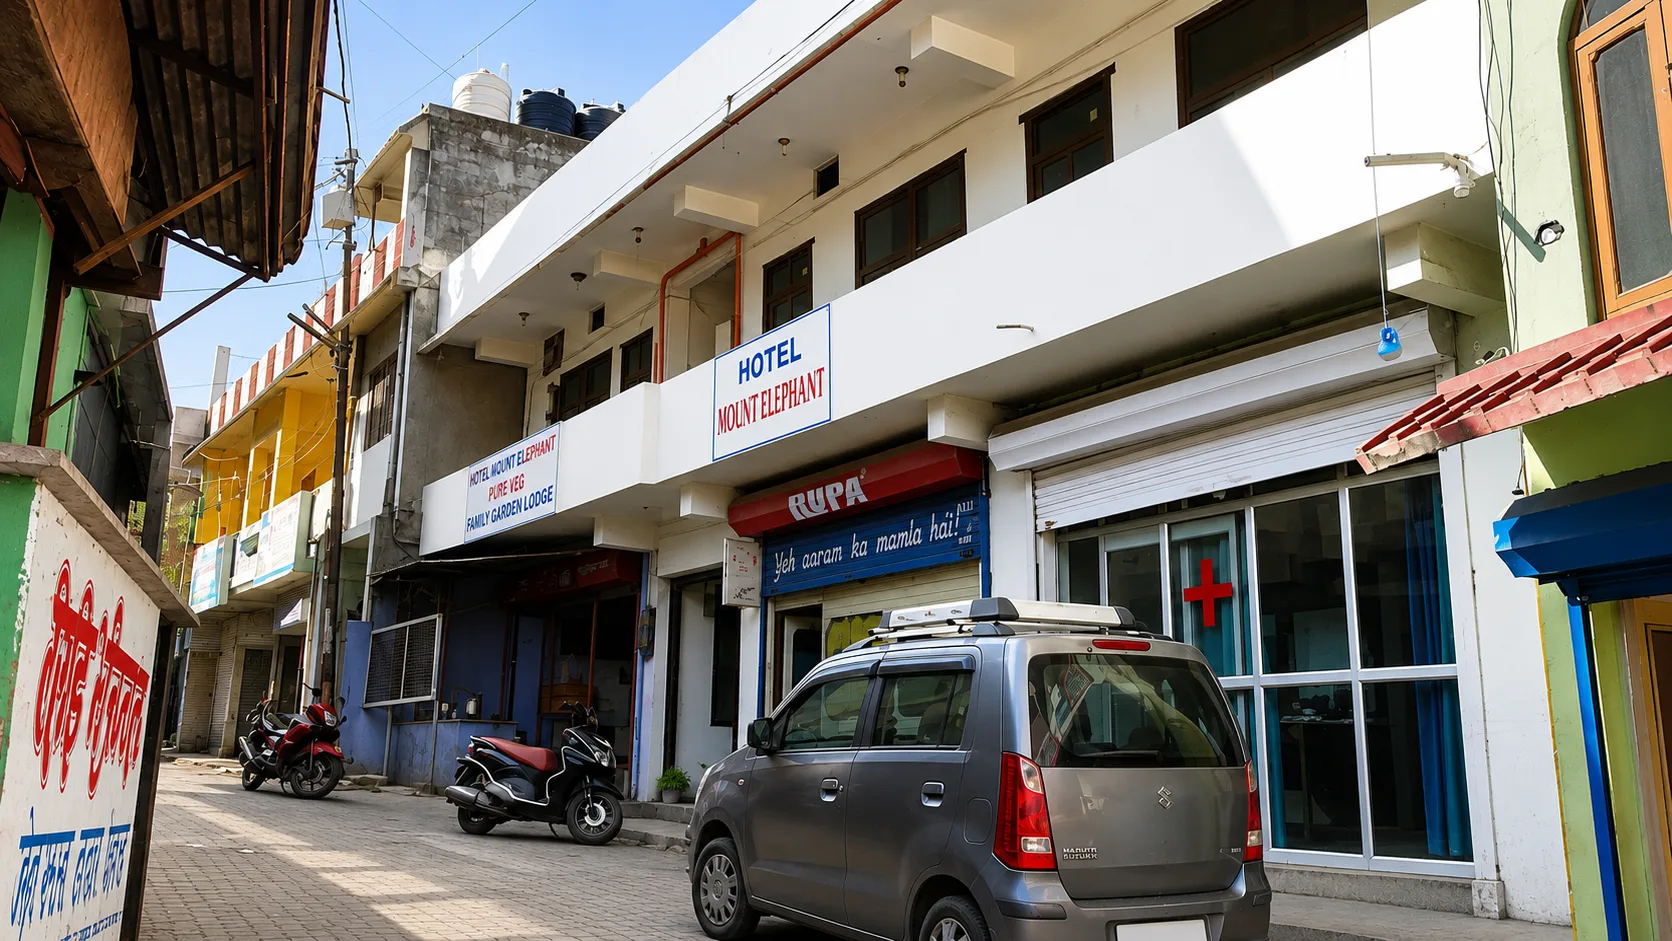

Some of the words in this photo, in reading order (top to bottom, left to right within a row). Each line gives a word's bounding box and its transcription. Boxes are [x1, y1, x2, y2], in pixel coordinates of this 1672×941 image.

[739, 336, 802, 385] HOTEL
[717, 393, 759, 435] MOUNT
[760, 367, 825, 420] ELEPHANT
[470, 467, 490, 487] HOTEL
[491, 453, 516, 477] MOUNT
[516, 434, 557, 466] ELEPHANT
[467, 509, 491, 532] FAMILY
[491, 497, 522, 523] GARDEN
[523, 484, 554, 512] LODGE
[488, 478, 508, 502] PURE
[509, 473, 525, 494] VEG
[788, 477, 868, 520] RUPA
[773, 551, 796, 583] Yeh
[802, 545, 843, 569] aaram
[850, 532, 868, 558] ka
[876, 518, 922, 554] mamla
[929, 504, 960, 542] hai!
